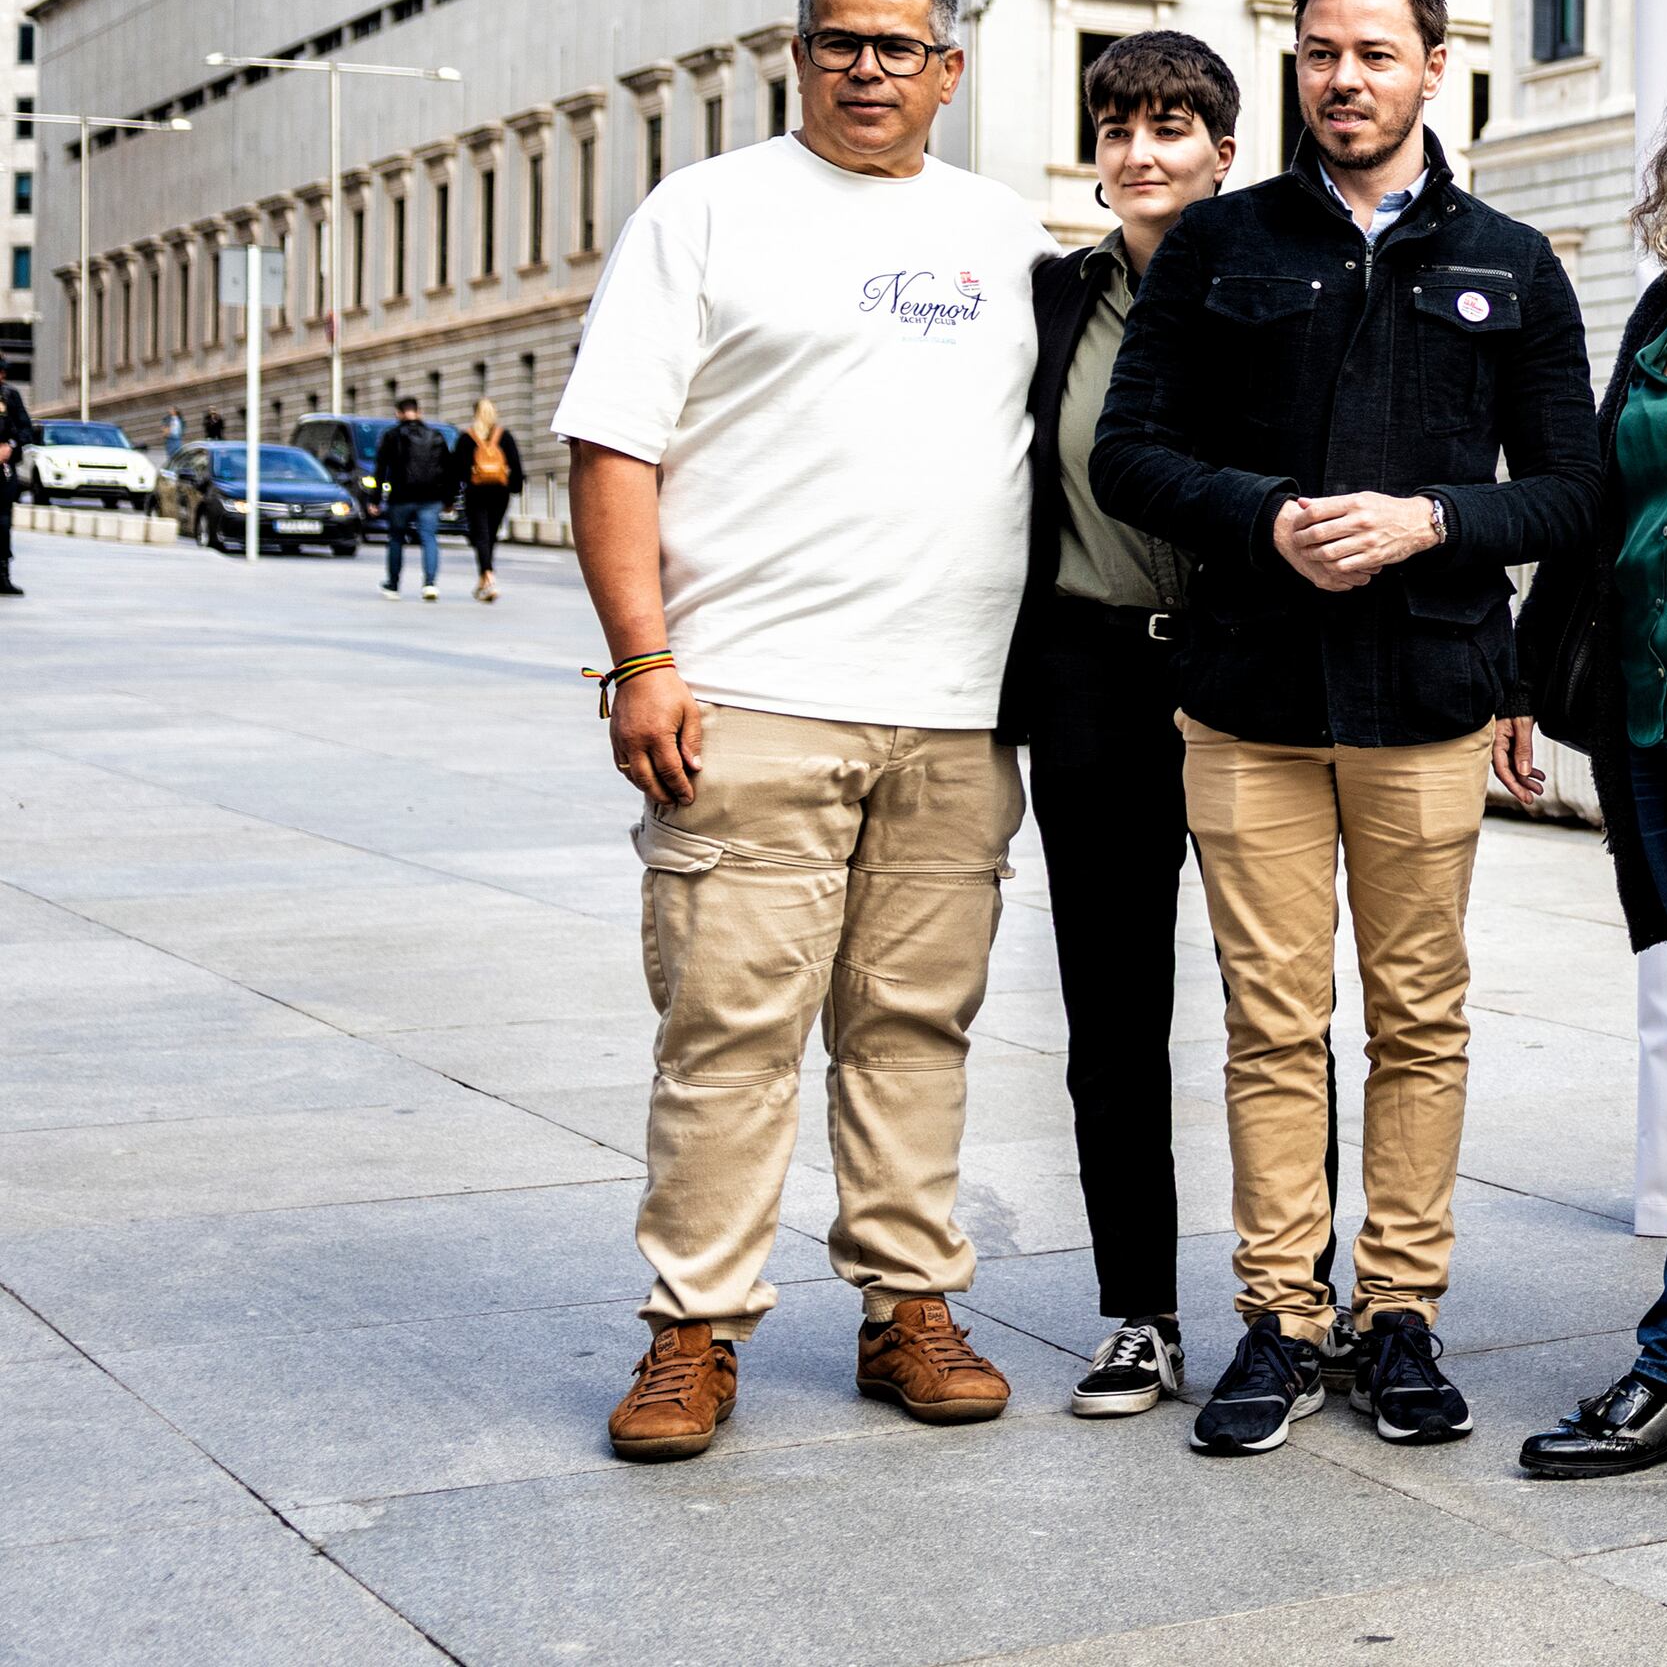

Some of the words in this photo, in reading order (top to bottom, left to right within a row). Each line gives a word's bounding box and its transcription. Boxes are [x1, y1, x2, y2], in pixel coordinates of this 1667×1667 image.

[859, 271, 987, 336] Newport
[899, 316, 928, 324] YACHT
[934, 318, 957, 326] CLUB
